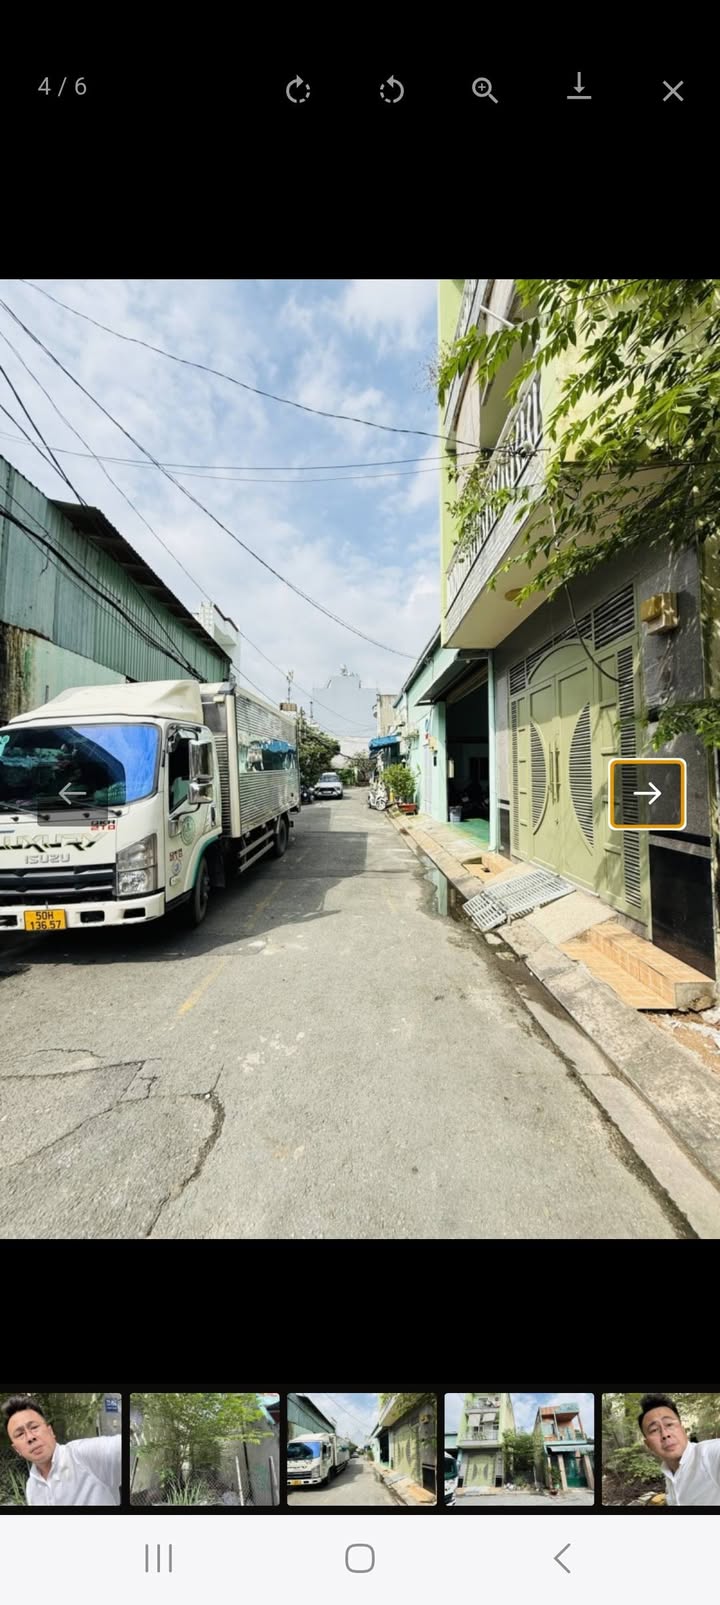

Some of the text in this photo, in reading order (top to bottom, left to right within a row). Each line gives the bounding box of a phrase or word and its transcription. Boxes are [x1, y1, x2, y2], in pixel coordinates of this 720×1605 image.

[0, 832, 107, 853] UXURY
[25, 853, 71, 864] ISUZU
[35, 911, 54, 921] 50H
